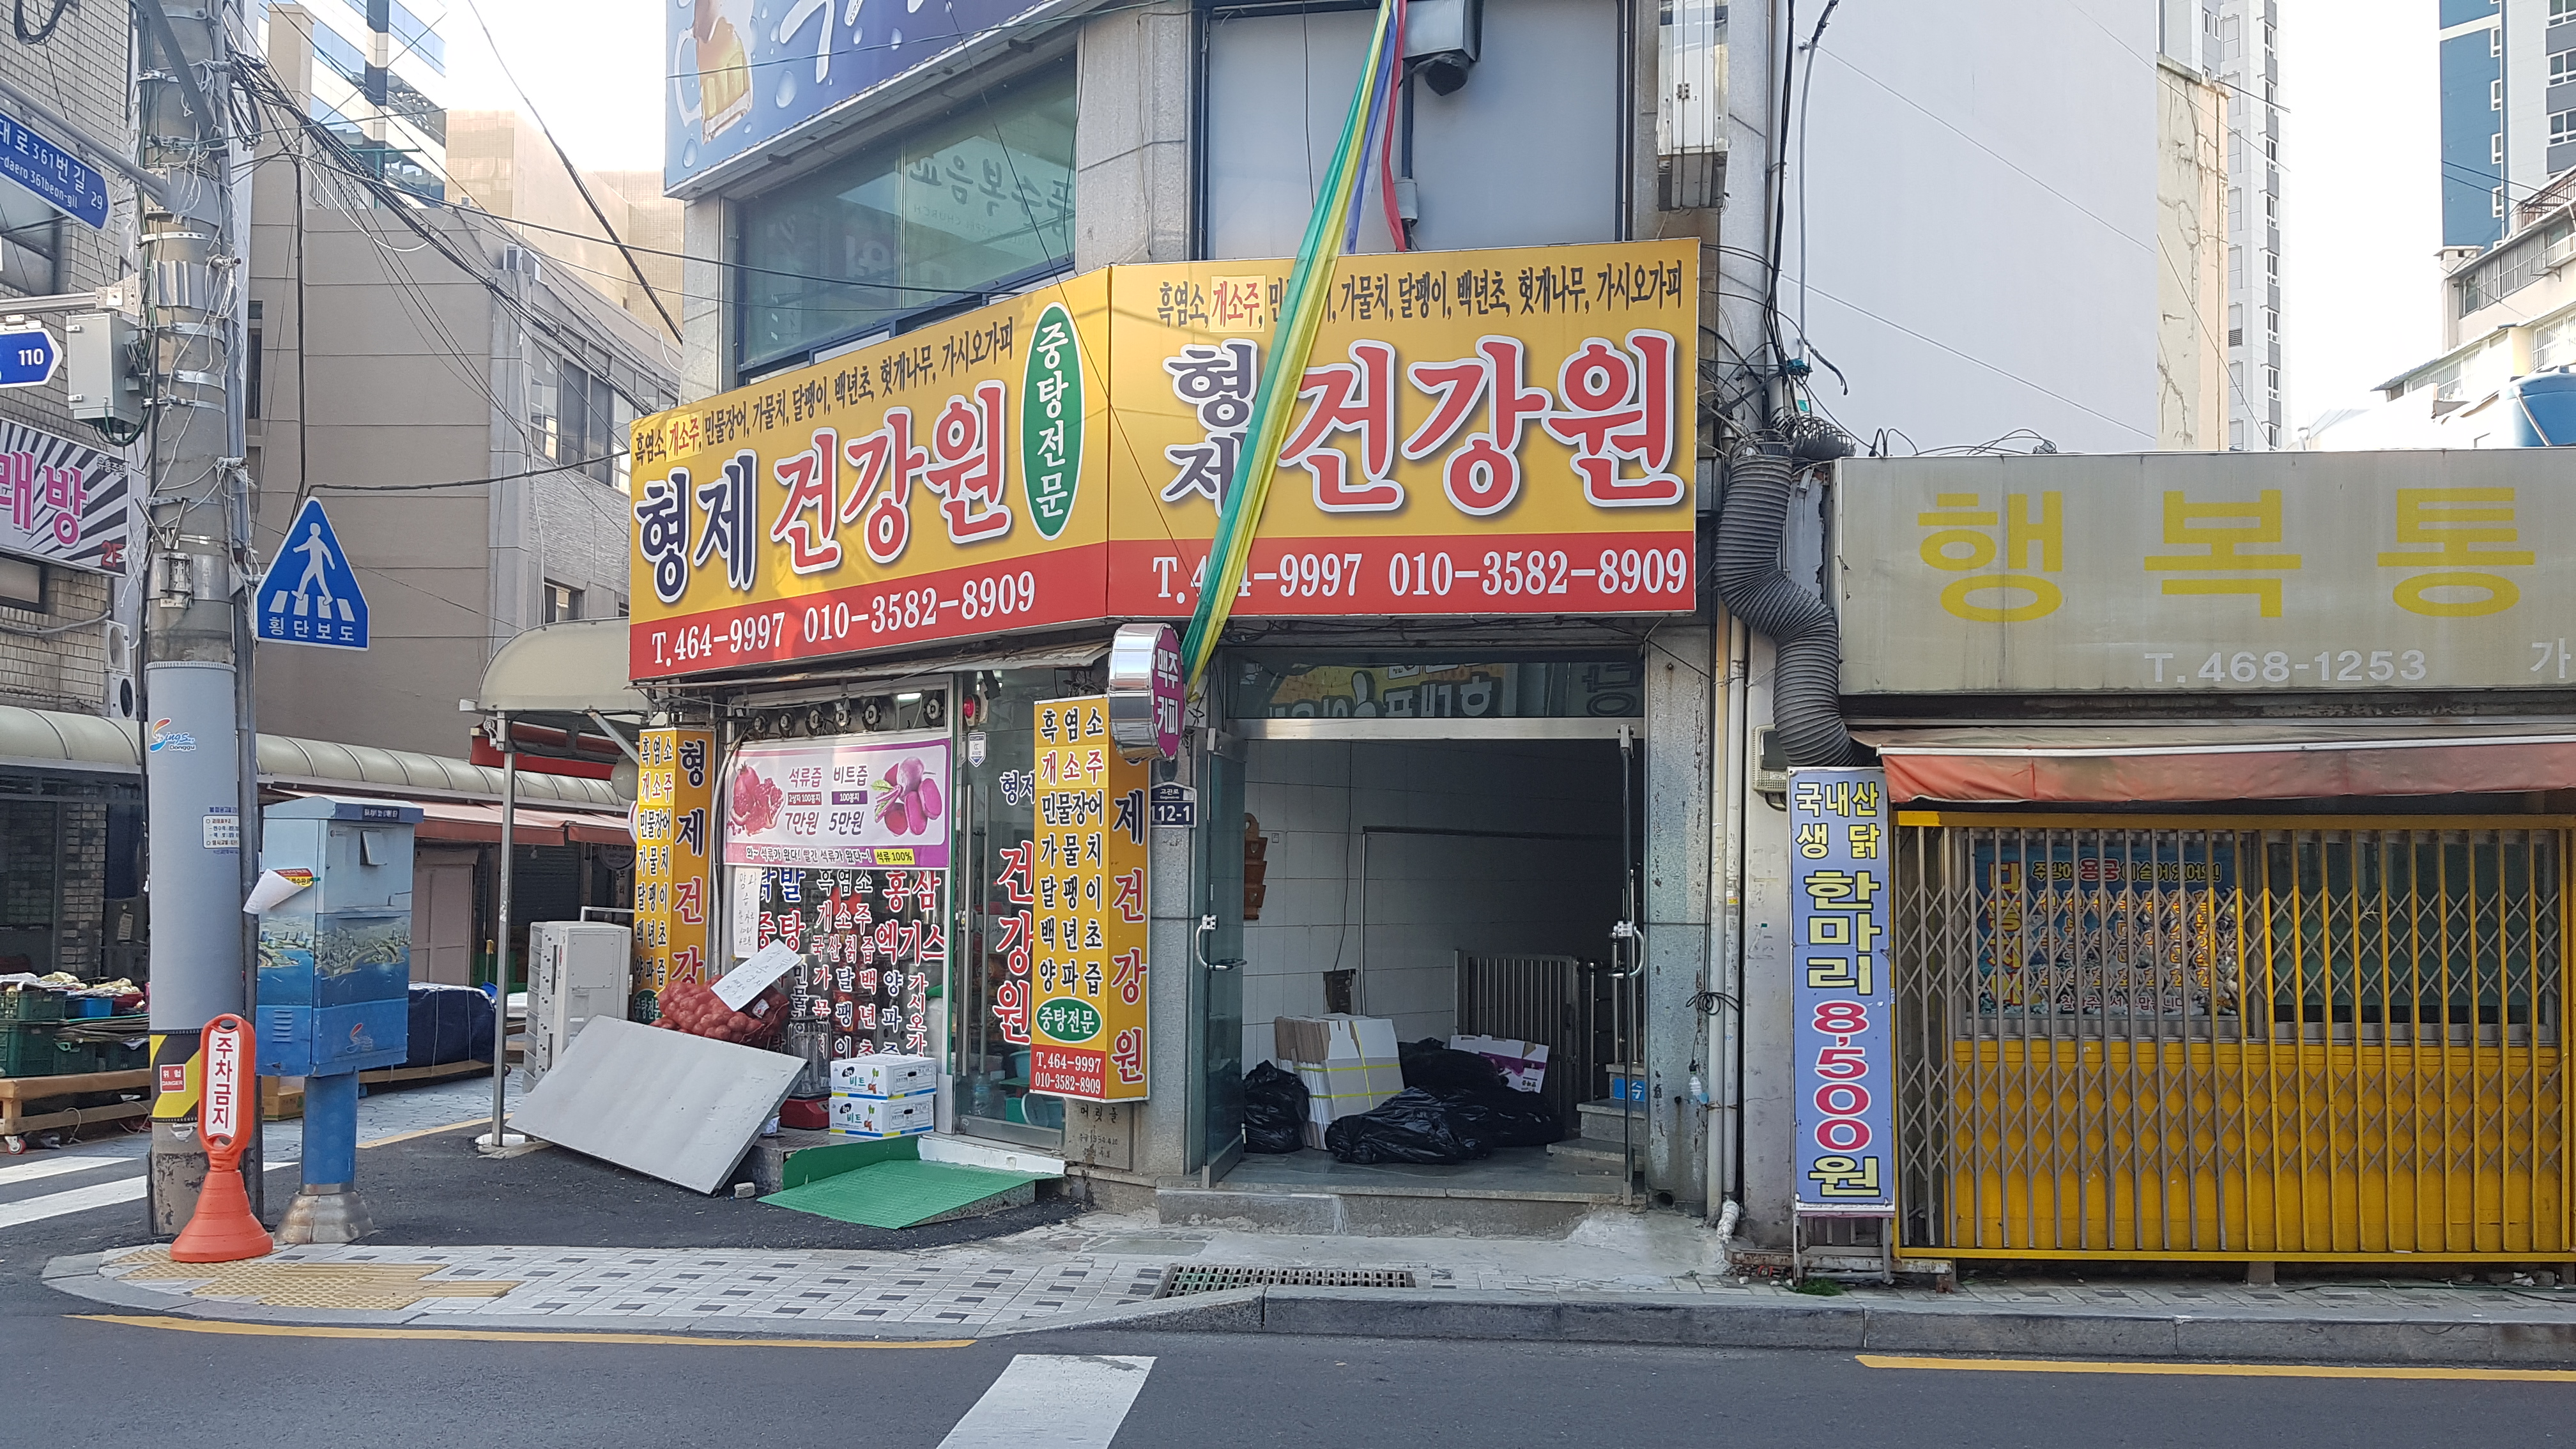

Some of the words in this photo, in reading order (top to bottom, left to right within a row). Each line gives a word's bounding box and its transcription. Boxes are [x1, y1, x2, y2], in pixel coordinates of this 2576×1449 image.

[30, 170, 79, 210] 361beon-gil
[91, 191, 103, 210] 29
[1157, 280, 1209, 328] 흑염소,
[1212, 280, 1262, 329] 개소주,
[1340, 273, 1393, 322] 가물치,
[1399, 271, 1452, 320] 달팽이,
[1456, 268, 1511, 318] 백년초,
[1597, 259, 1682, 312] 가시오가피
[18, 348, 44, 366] 110
[634, 428, 667, 466] 흑염소,
[669, 417, 702, 456] 개소주,
[705, 401, 750, 446] 민물장어,
[753, 388, 789, 433] 가물치,
[792, 376, 831, 422] 달팽이,
[834, 365, 874, 410] 백년초,
[942, 316, 1013, 378] 가시오가피
[1036, 321, 1070, 519] 중탕전문
[1279, 331, 1682, 514] 건강원
[96, 456, 126, 479] 유흥주점
[636, 451, 756, 599] 형제
[772, 383, 1010, 572] 건강원
[101, 540, 125, 568] 2F
[1389, 549, 1687, 597] 010-3582-8909
[268, 617, 355, 641] 횡단보도
[652, 612, 786, 666] T.464-9997
[804, 571, 1036, 643] 010-3582-8909
[1158, 648, 1179, 689] 맥주
[2530, 639, 2572, 680] 가
[1041, 707, 1104, 744] 흑염소
[1157, 695, 1179, 735] 커피
[641, 736, 673, 765] 흑염소
[1041, 749, 1104, 785] 개소주
[641, 772, 673, 801] 개소주
[789, 767, 823, 788] 석류즙
[833, 764, 869, 786] 비트즙
[677, 740, 706, 857] 형제
[839, 792, 860, 803] 100봉지
[1041, 789, 1103, 826] 민물장어
[1151, 805, 1190, 822] 112-1
[1795, 781, 1879, 817] 국내산
[640, 809, 671, 839] 민물장어
[785, 811, 820, 836] 7만원
[829, 811, 865, 836] 5만원
[638, 845, 669, 876] 가물치
[761, 847, 781, 861] 석류가
[783, 847, 801, 861] 왔다!
[820, 848, 843, 862] 석류가
[877, 850, 891, 864] 석류
[891, 849, 913, 862] 100%
[1040, 832, 1102, 869] 가물치
[637, 882, 668, 913] 달팽이
[816, 869, 873, 897] 흑염소
[882, 870, 941, 912] 홍삼
[1039, 875, 1102, 912] 달팽이
[636, 919, 667, 948] 백년초
[816, 900, 872, 935] 개소주
[1039, 915, 1103, 952] 백년초
[1803, 870, 1882, 995] 한마리
[875, 919, 945, 966] 엑기스
[993, 841, 1034, 1045] 건강원
[634, 955, 666, 987] 양파즙
[1039, 958, 1103, 997] 양파즙
[1111, 867, 1147, 1084] 건강원
[834, 967, 856, 1059] 달팽이
[906, 972, 929, 1057] 가시오가
[1039, 1006, 1095, 1034] 중탕전문
[163, 1069, 181, 1078] 위험
[1036, 1051, 1101, 1074] T.464-9997
[212, 1037, 233, 1129] 주차금지
[850, 1075, 866, 1087] 비트
[1035, 1071, 1101, 1094] 010-3582-8909
[847, 1112, 862, 1123] 비트
[1080, 1103, 1118, 1123] 머릿돌
